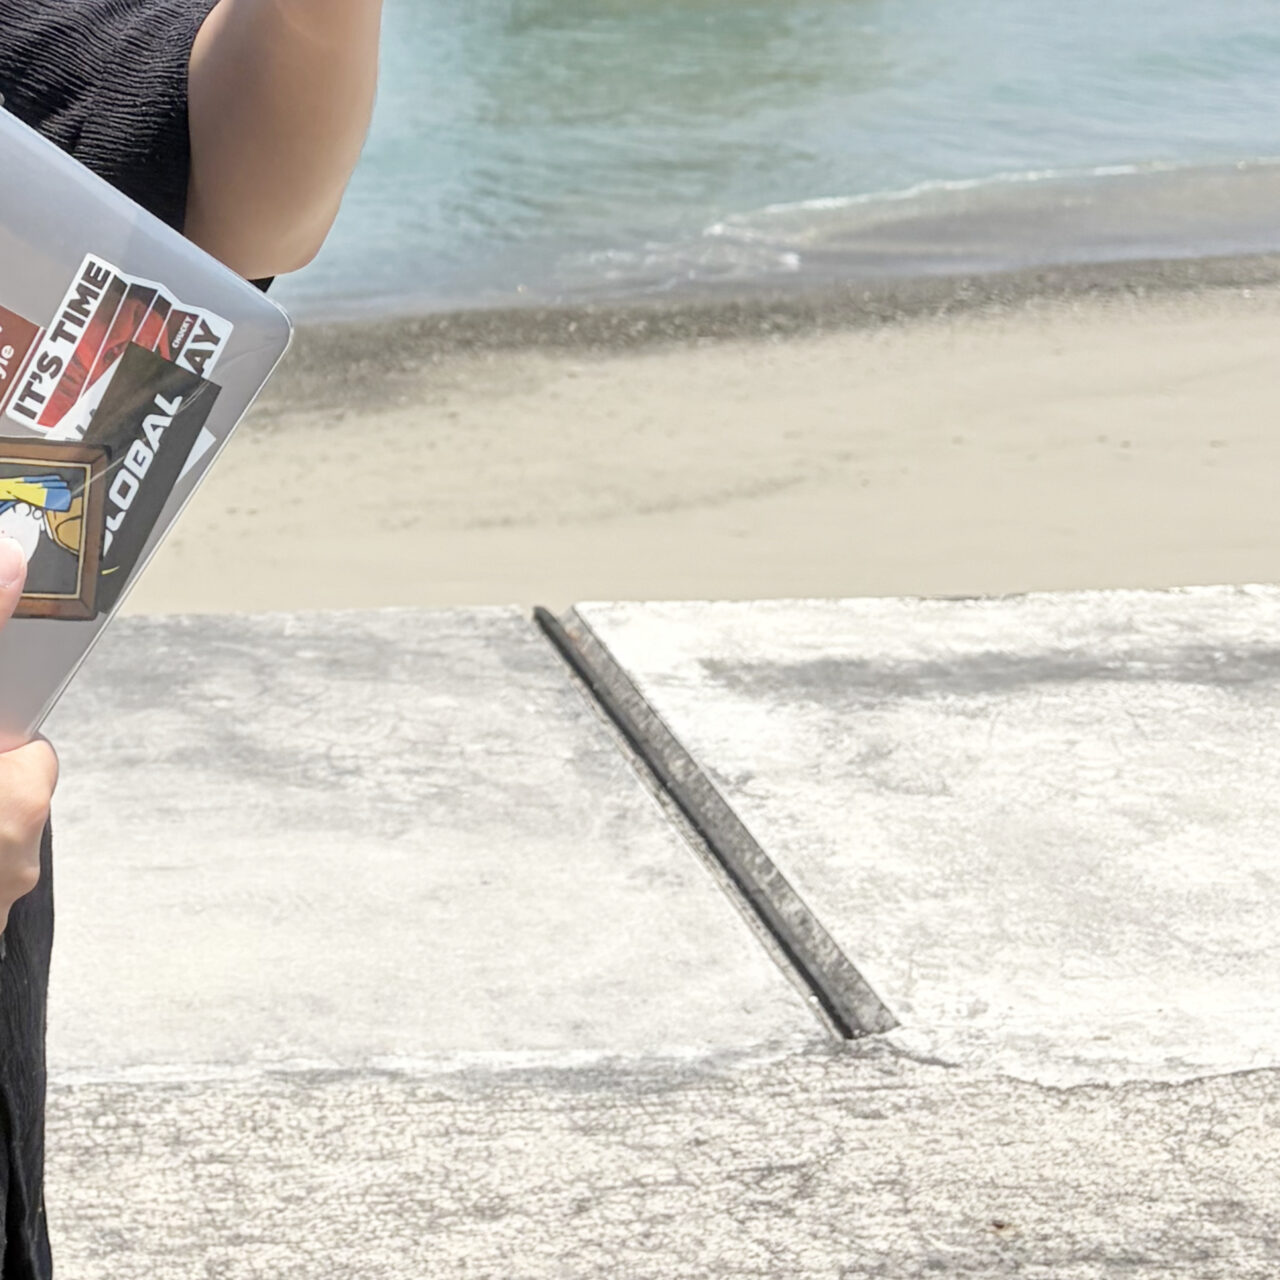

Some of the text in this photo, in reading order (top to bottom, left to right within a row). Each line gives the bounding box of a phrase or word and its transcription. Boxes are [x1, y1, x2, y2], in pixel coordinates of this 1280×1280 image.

[12, 350, 64, 420] IT'S
[49, 260, 111, 344] TIME
[102, 393, 183, 558] LOBAL
